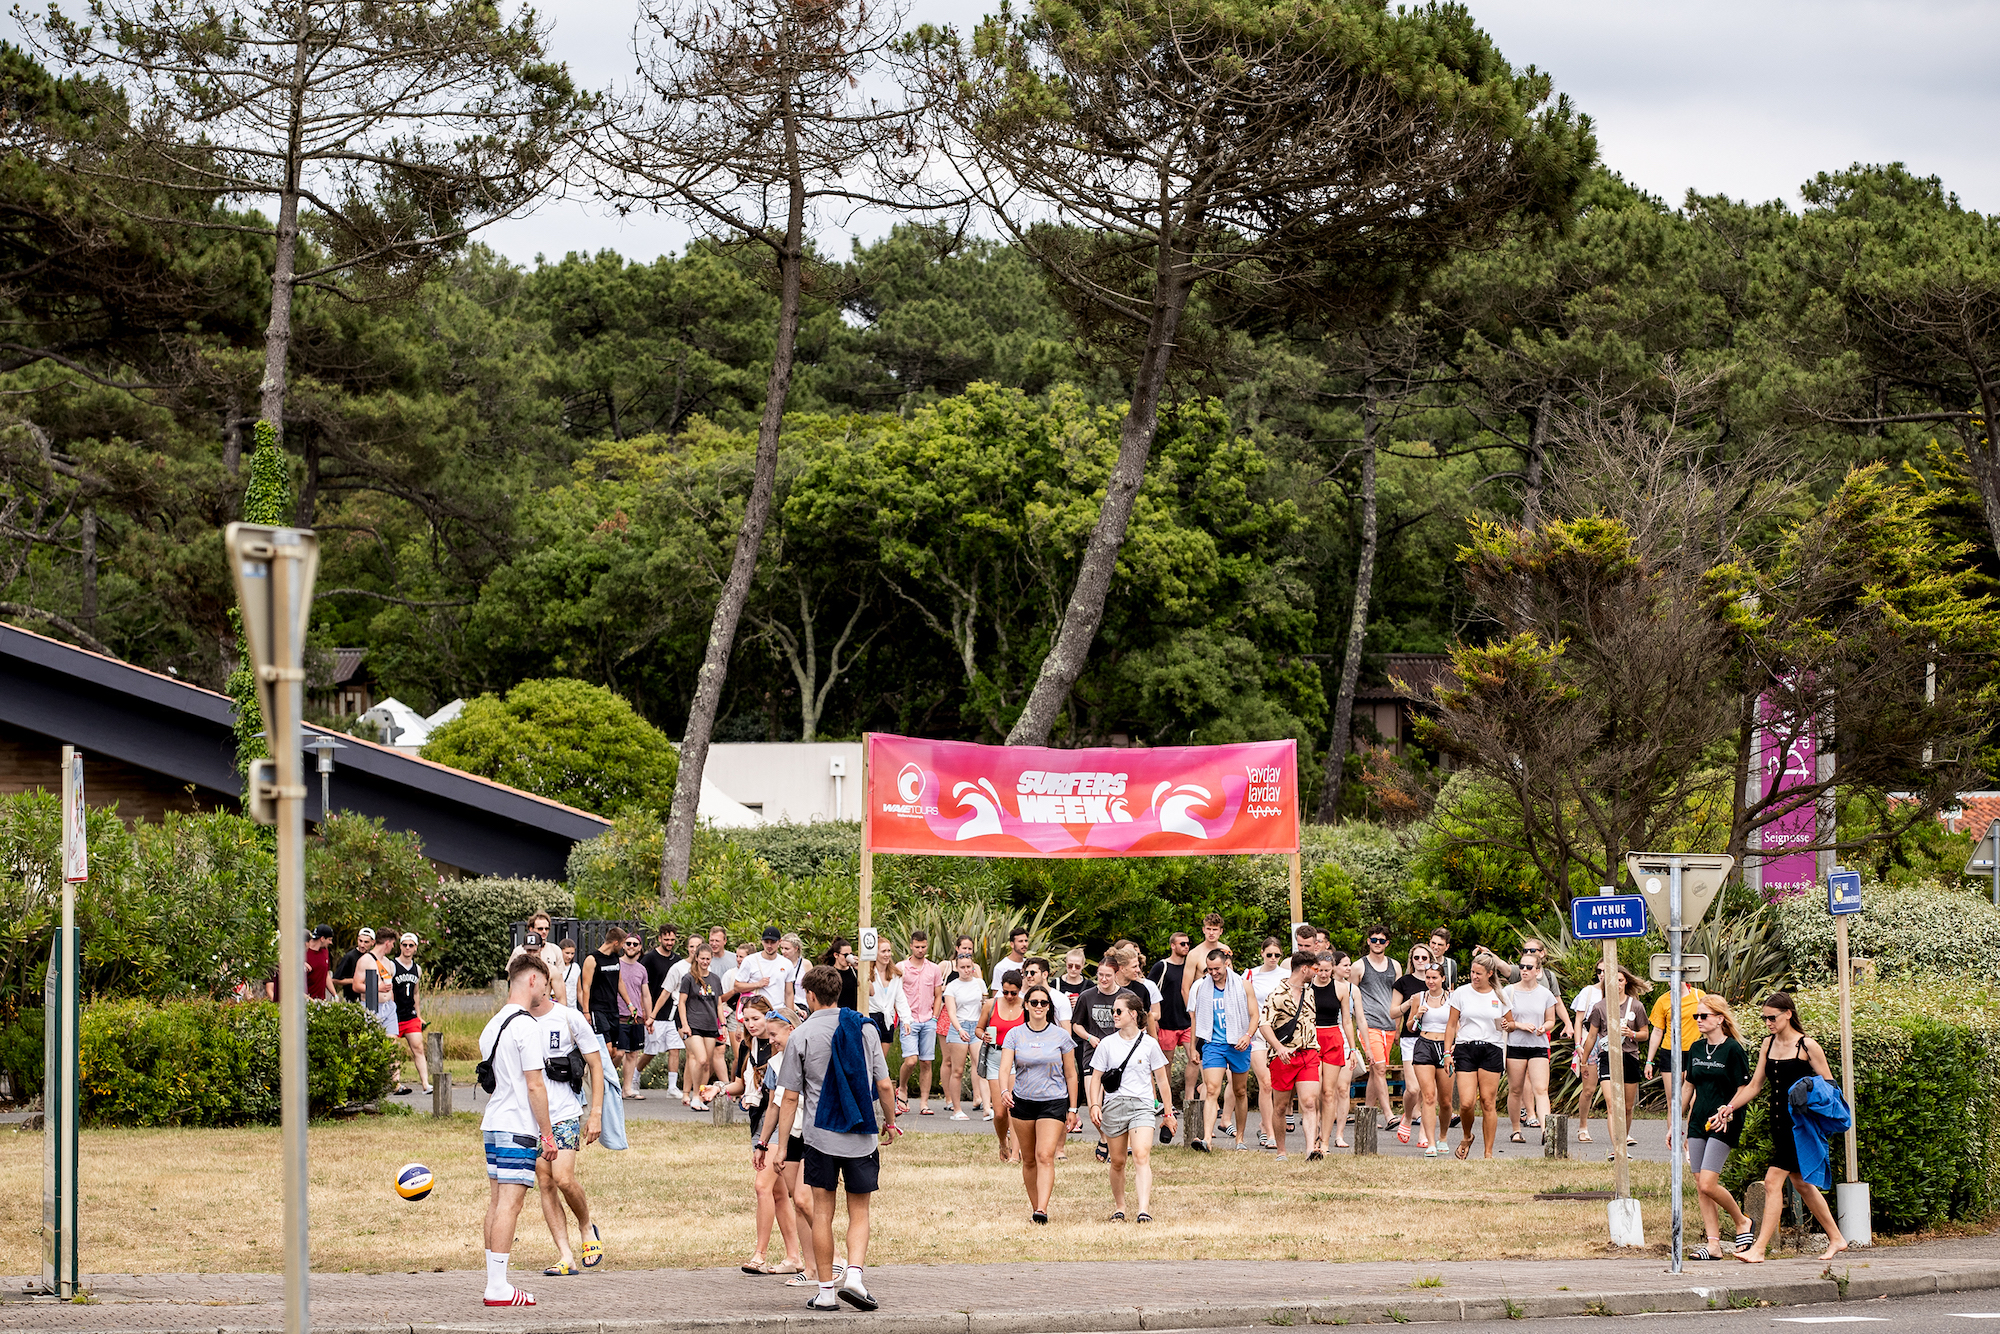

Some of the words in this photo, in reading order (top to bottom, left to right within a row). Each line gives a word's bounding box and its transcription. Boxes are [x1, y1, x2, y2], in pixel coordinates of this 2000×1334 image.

[1245, 764, 1281, 783] layday
[1016, 770, 1129, 796] SURFERS
[1248, 783, 1281, 802] layday
[1016, 795, 1113, 824] WEEK
[1764, 831, 1810, 846] Seignosse
[1592, 904, 1626, 915] AVENUE
[1588, 920, 1598, 930] du
[1602, 918, 1632, 929] PENON
[406, 983, 410, 996] 1
